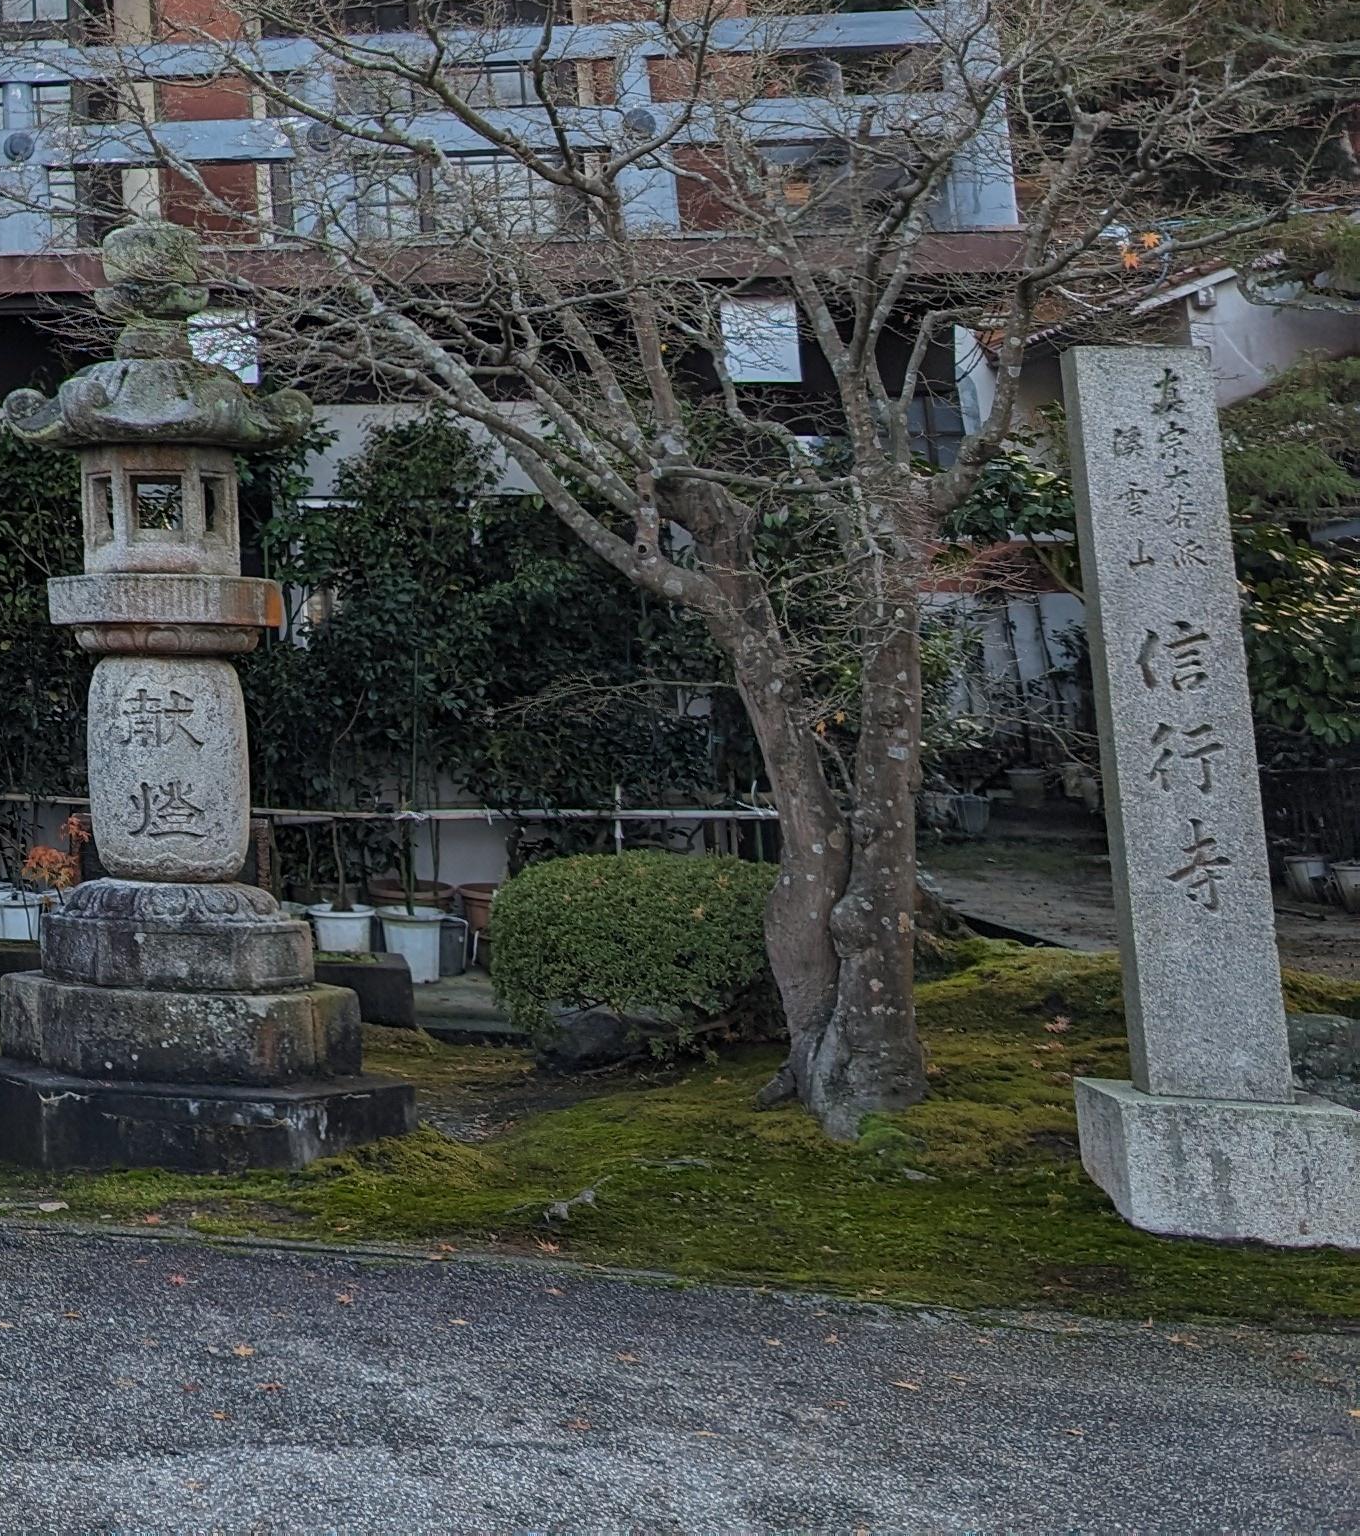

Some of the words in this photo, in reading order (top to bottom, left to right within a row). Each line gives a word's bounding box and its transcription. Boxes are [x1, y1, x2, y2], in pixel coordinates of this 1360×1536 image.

[120, 687, 206, 839] 献燈
[1135, 618, 1234, 914] 信行寺
